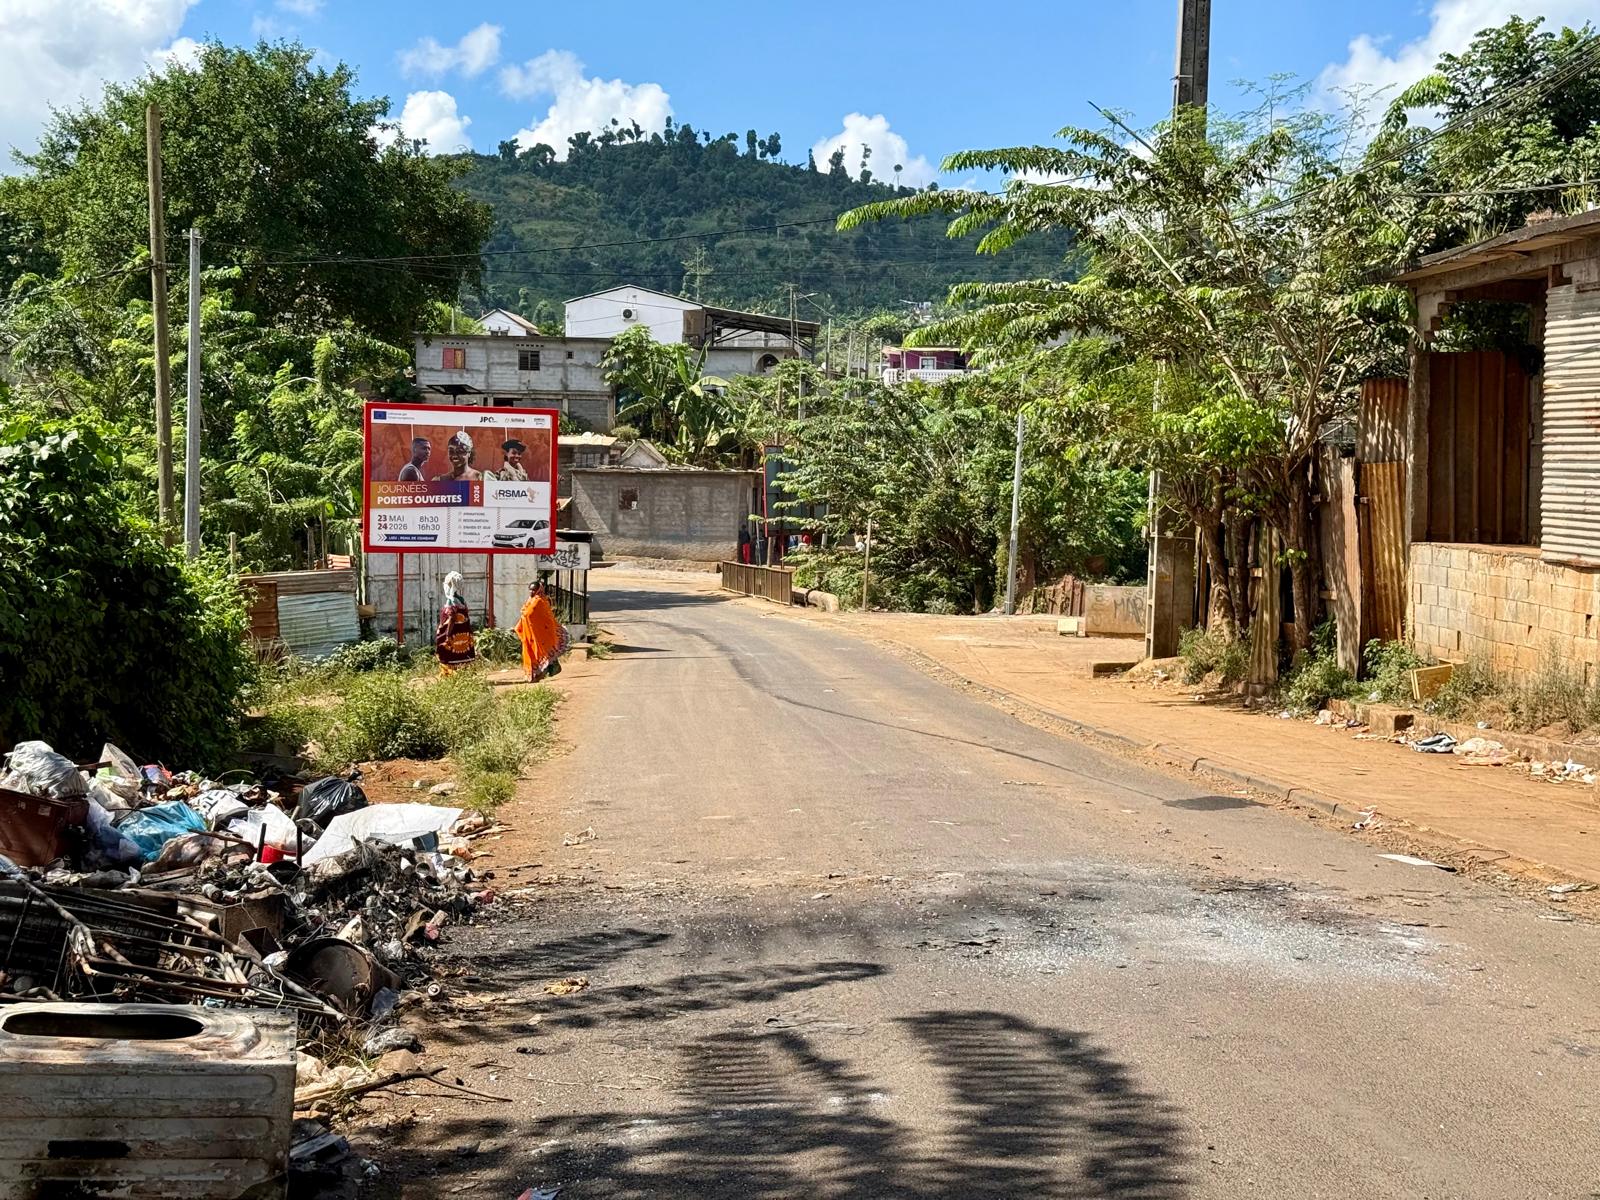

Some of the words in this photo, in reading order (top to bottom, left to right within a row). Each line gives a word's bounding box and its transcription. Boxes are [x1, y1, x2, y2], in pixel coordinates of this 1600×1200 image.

[377, 482, 428, 494] JOURNÉES
[498, 489, 528, 498] RSMA
[377, 496, 413, 505] PORTES
[414, 494, 462, 504] OUVERTES
[377, 514, 388, 522] 23
[419, 515, 439, 523] 8h30
[389, 523, 408, 531] 2026
